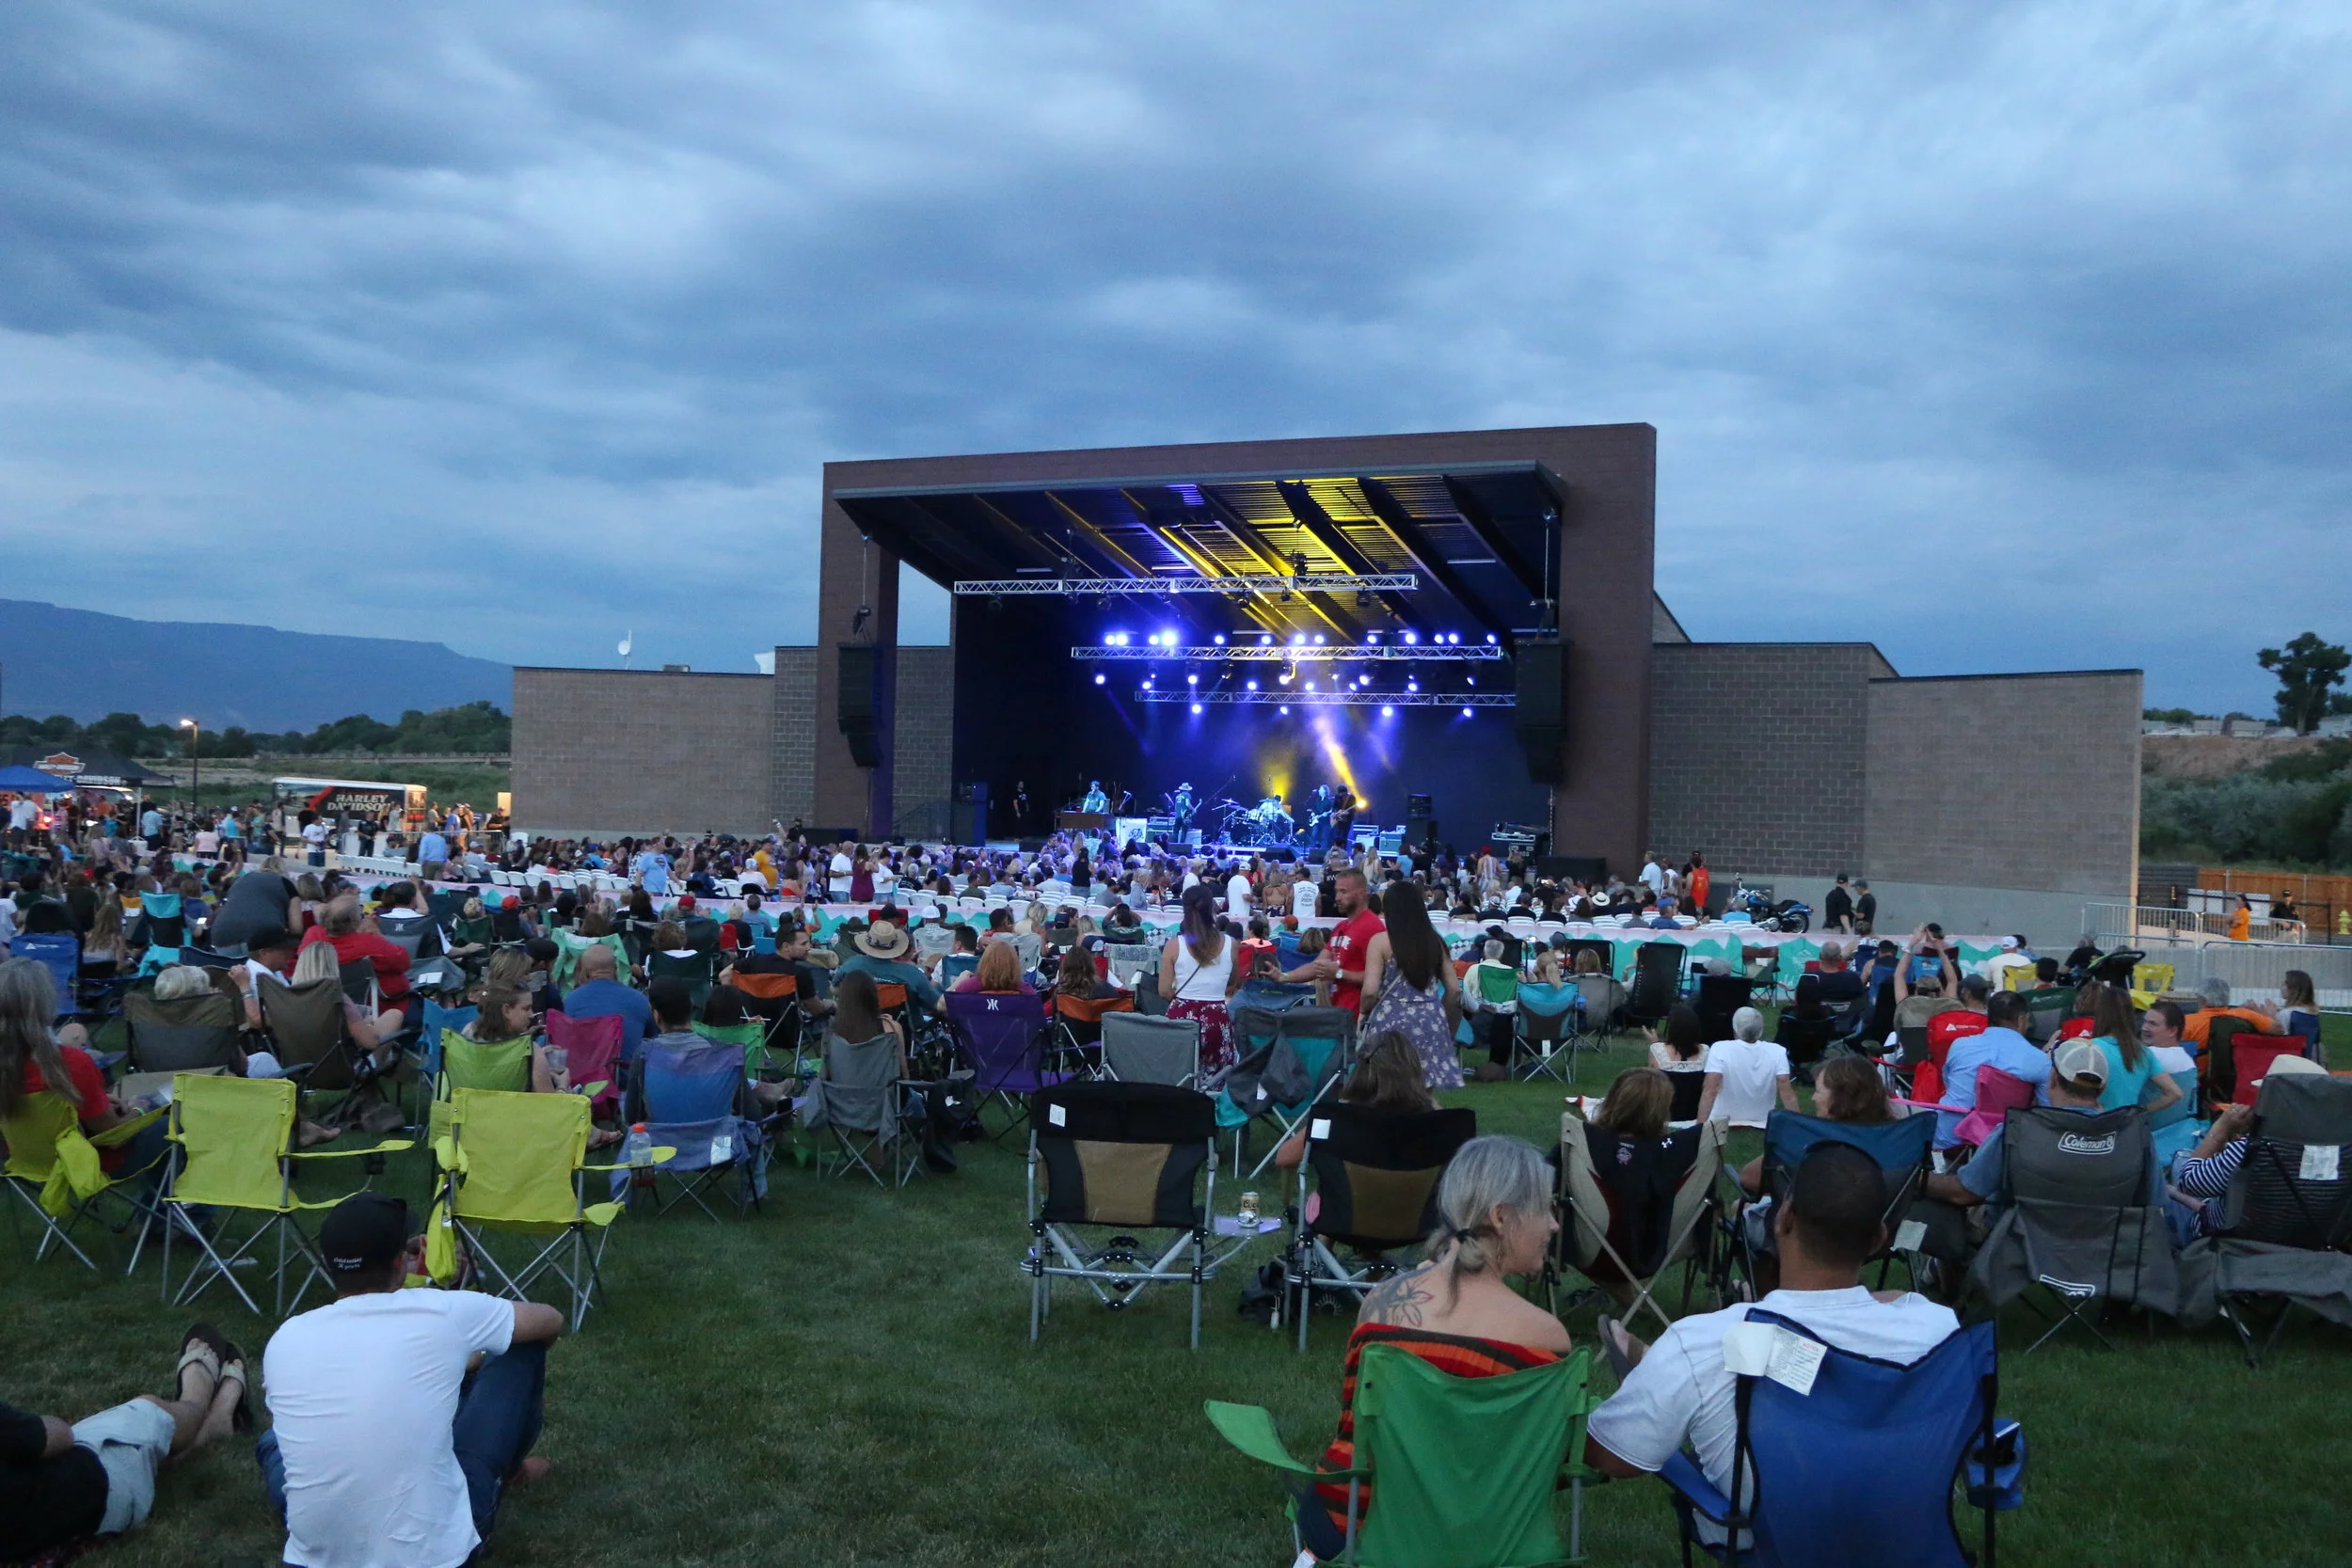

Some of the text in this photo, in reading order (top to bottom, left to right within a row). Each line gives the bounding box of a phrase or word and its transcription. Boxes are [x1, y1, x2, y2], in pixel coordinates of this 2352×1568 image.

[336, 794, 389, 803] HARLEY
[326, 802, 391, 812] DAIDSO
[2064, 1134, 2106, 1148] Coleman
